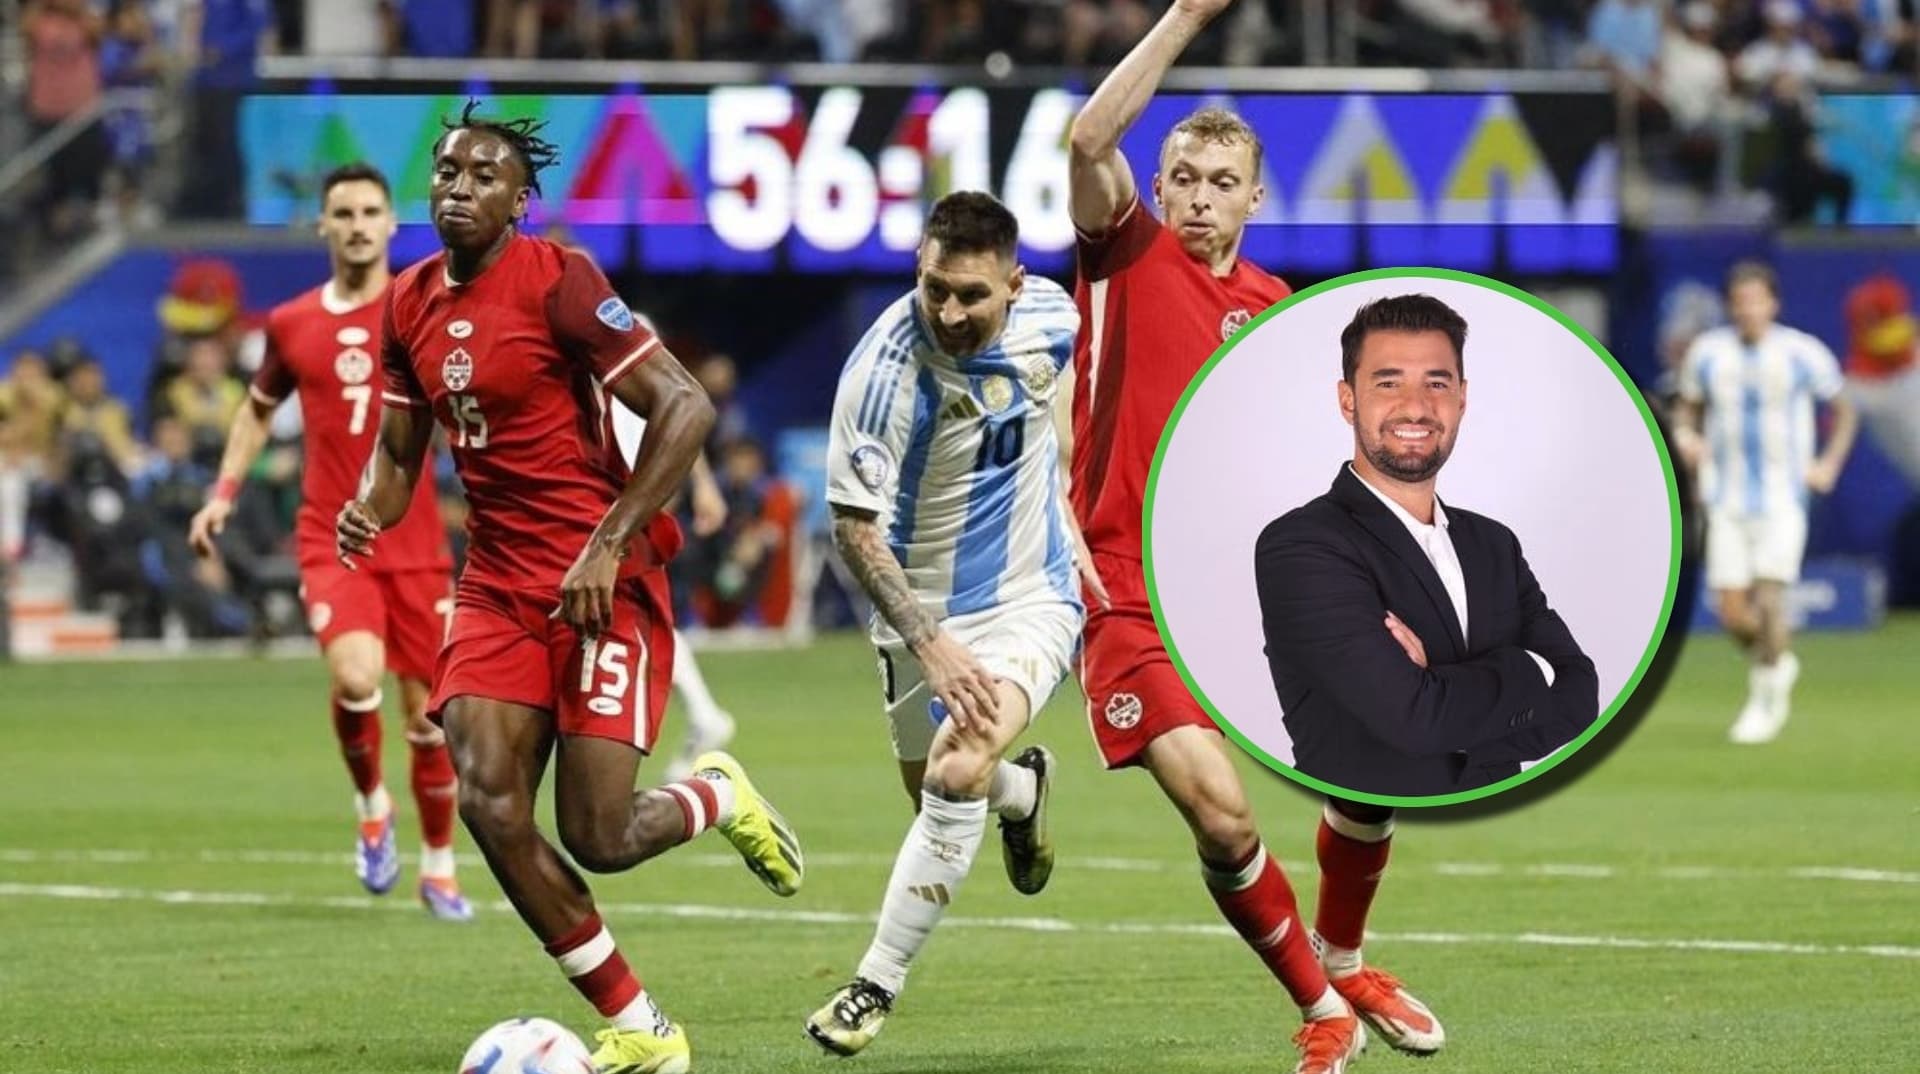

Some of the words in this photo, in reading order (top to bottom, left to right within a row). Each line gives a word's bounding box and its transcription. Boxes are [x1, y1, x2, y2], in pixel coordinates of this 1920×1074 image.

[706, 86, 1071, 251] 56:16
[341, 384, 372, 435] 7
[449, 396, 488, 448] 15
[974, 415, 1024, 472] 10
[580, 638, 630, 698] 15
